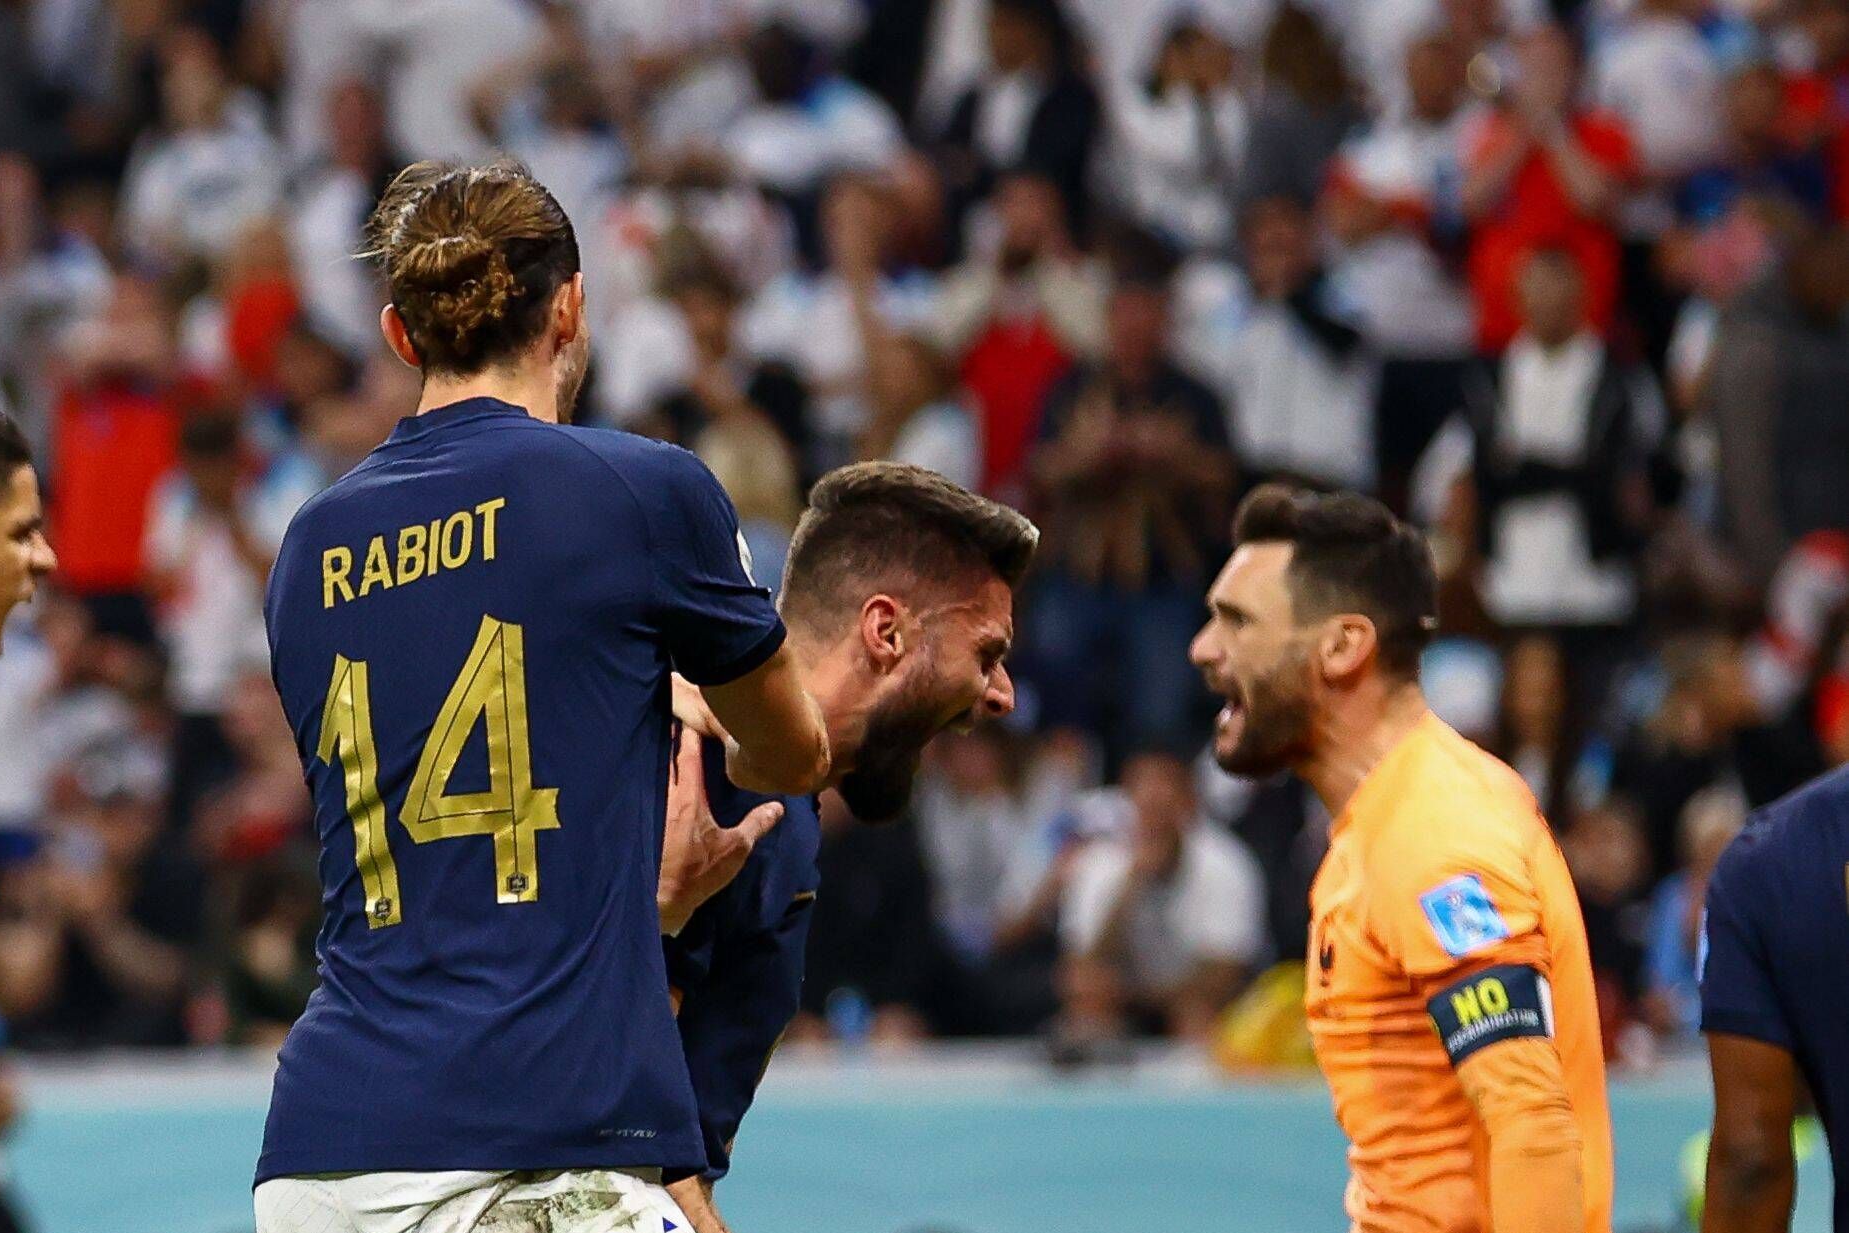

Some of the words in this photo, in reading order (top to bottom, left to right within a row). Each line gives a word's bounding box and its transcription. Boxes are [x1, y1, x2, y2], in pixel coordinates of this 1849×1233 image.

[322, 497, 505, 609] RABIOT
[316, 613, 562, 929] 14
[1451, 977, 1510, 1026] NO
